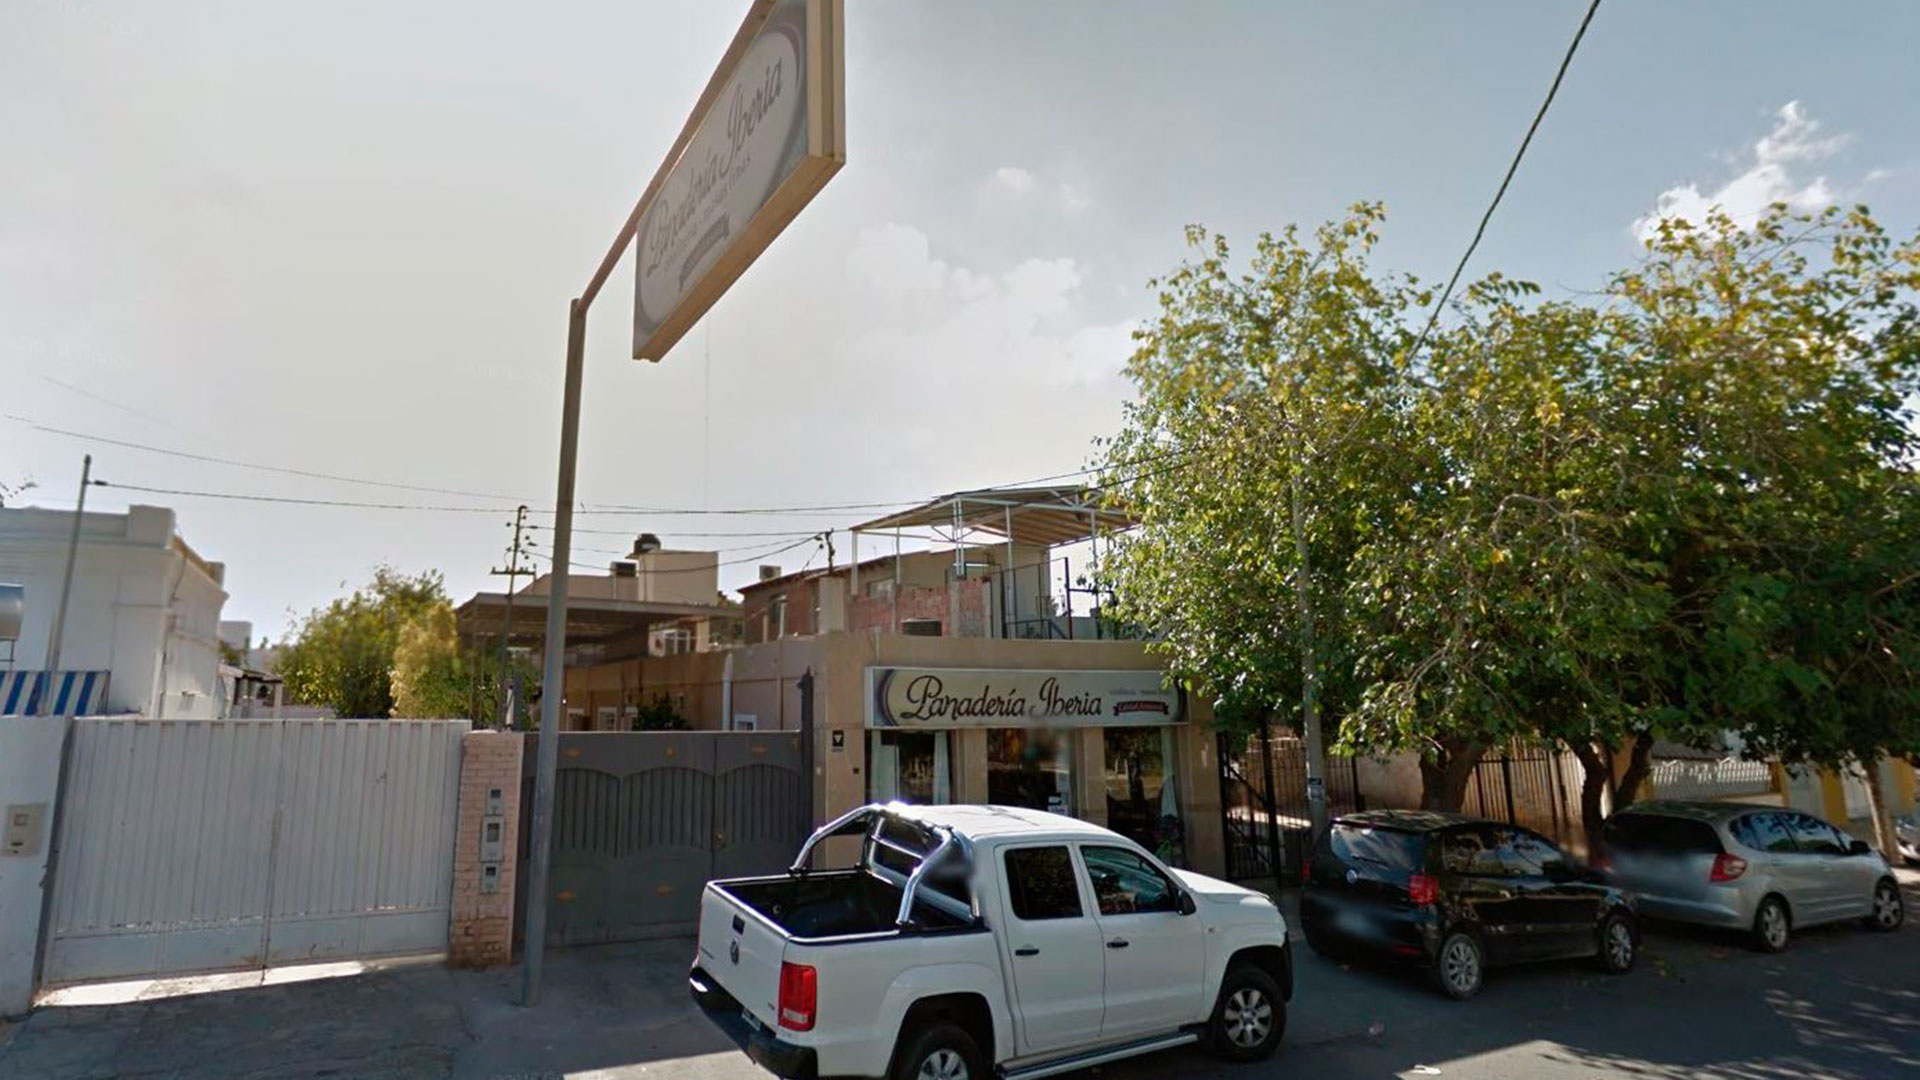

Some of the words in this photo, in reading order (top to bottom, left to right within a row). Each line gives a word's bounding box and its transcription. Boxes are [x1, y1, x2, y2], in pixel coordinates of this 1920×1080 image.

[719, 57, 782, 179] Iberia
[900, 675, 1026, 721] Panadería
[1029, 677, 1102, 718] Iberia
